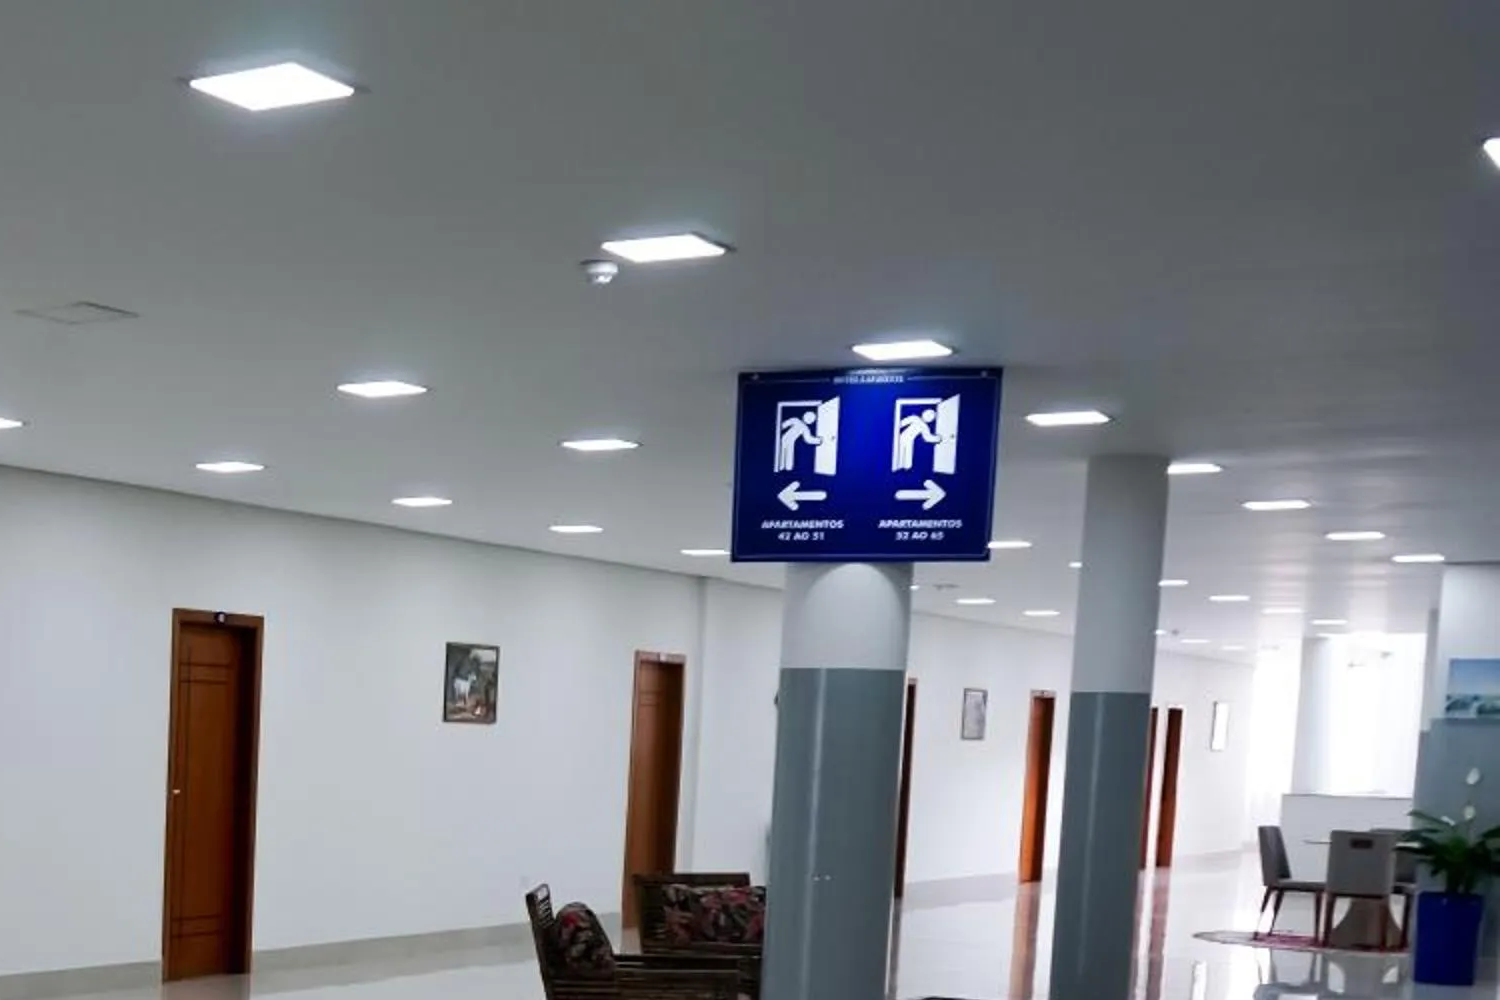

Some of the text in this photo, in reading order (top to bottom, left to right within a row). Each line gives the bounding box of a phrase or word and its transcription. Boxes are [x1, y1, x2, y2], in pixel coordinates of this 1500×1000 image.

[761, 519, 845, 529] APARTAMENTOS
[878, 519, 963, 529] APARTAMENTOS
[793, 531, 810, 541] AO
[911, 531, 928, 541] AO
